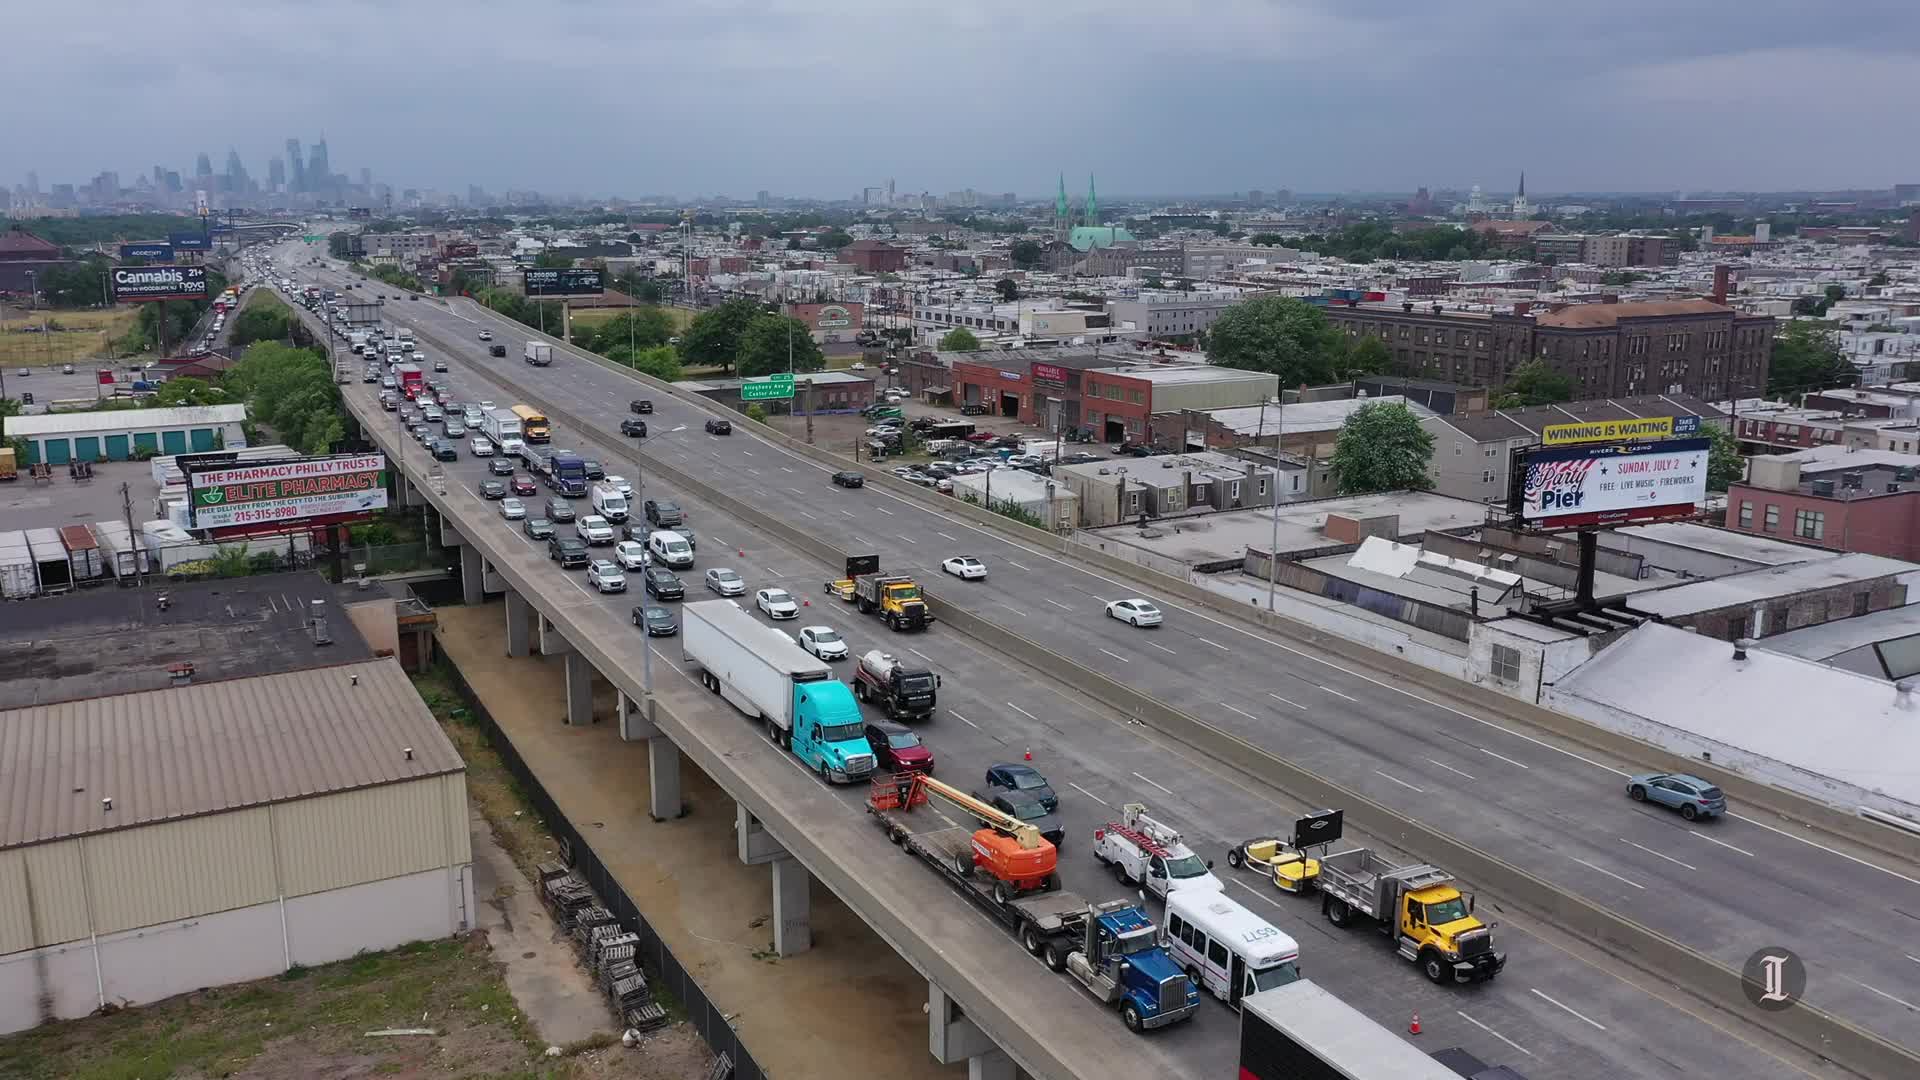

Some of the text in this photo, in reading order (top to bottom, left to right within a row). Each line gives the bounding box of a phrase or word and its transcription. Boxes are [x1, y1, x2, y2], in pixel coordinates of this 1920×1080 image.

[115, 269, 183, 283] Cannabis
[188, 268, 203, 277] 21+
[179, 281, 205, 289] nova
[1547, 421, 1668, 440] WINNING IS WAITING
[200, 457, 379, 484] THE PHARMACY PHILLY TRUSTS
[1618, 459, 1680, 474] SUNDAY, JULY 2
[225, 472, 379, 502] ELITE PHARMACY
[1534, 464, 1587, 494] Party
[1600, 475, 1695, 491] FREE LIVE MUSIC FIREWORKS
[217, 503, 251, 513] DELIVERY
[252, 501, 272, 509] FROM
[273, 499, 287, 507] THE
[287, 497, 302, 506] CITY
[303, 496, 314, 504] TO
[328, 491, 360, 501] SUBURBS
[1542, 489, 1583, 509] Pier
[234, 506, 297, 522] 215-315-8980
[1242, 927, 1278, 942] 6577
